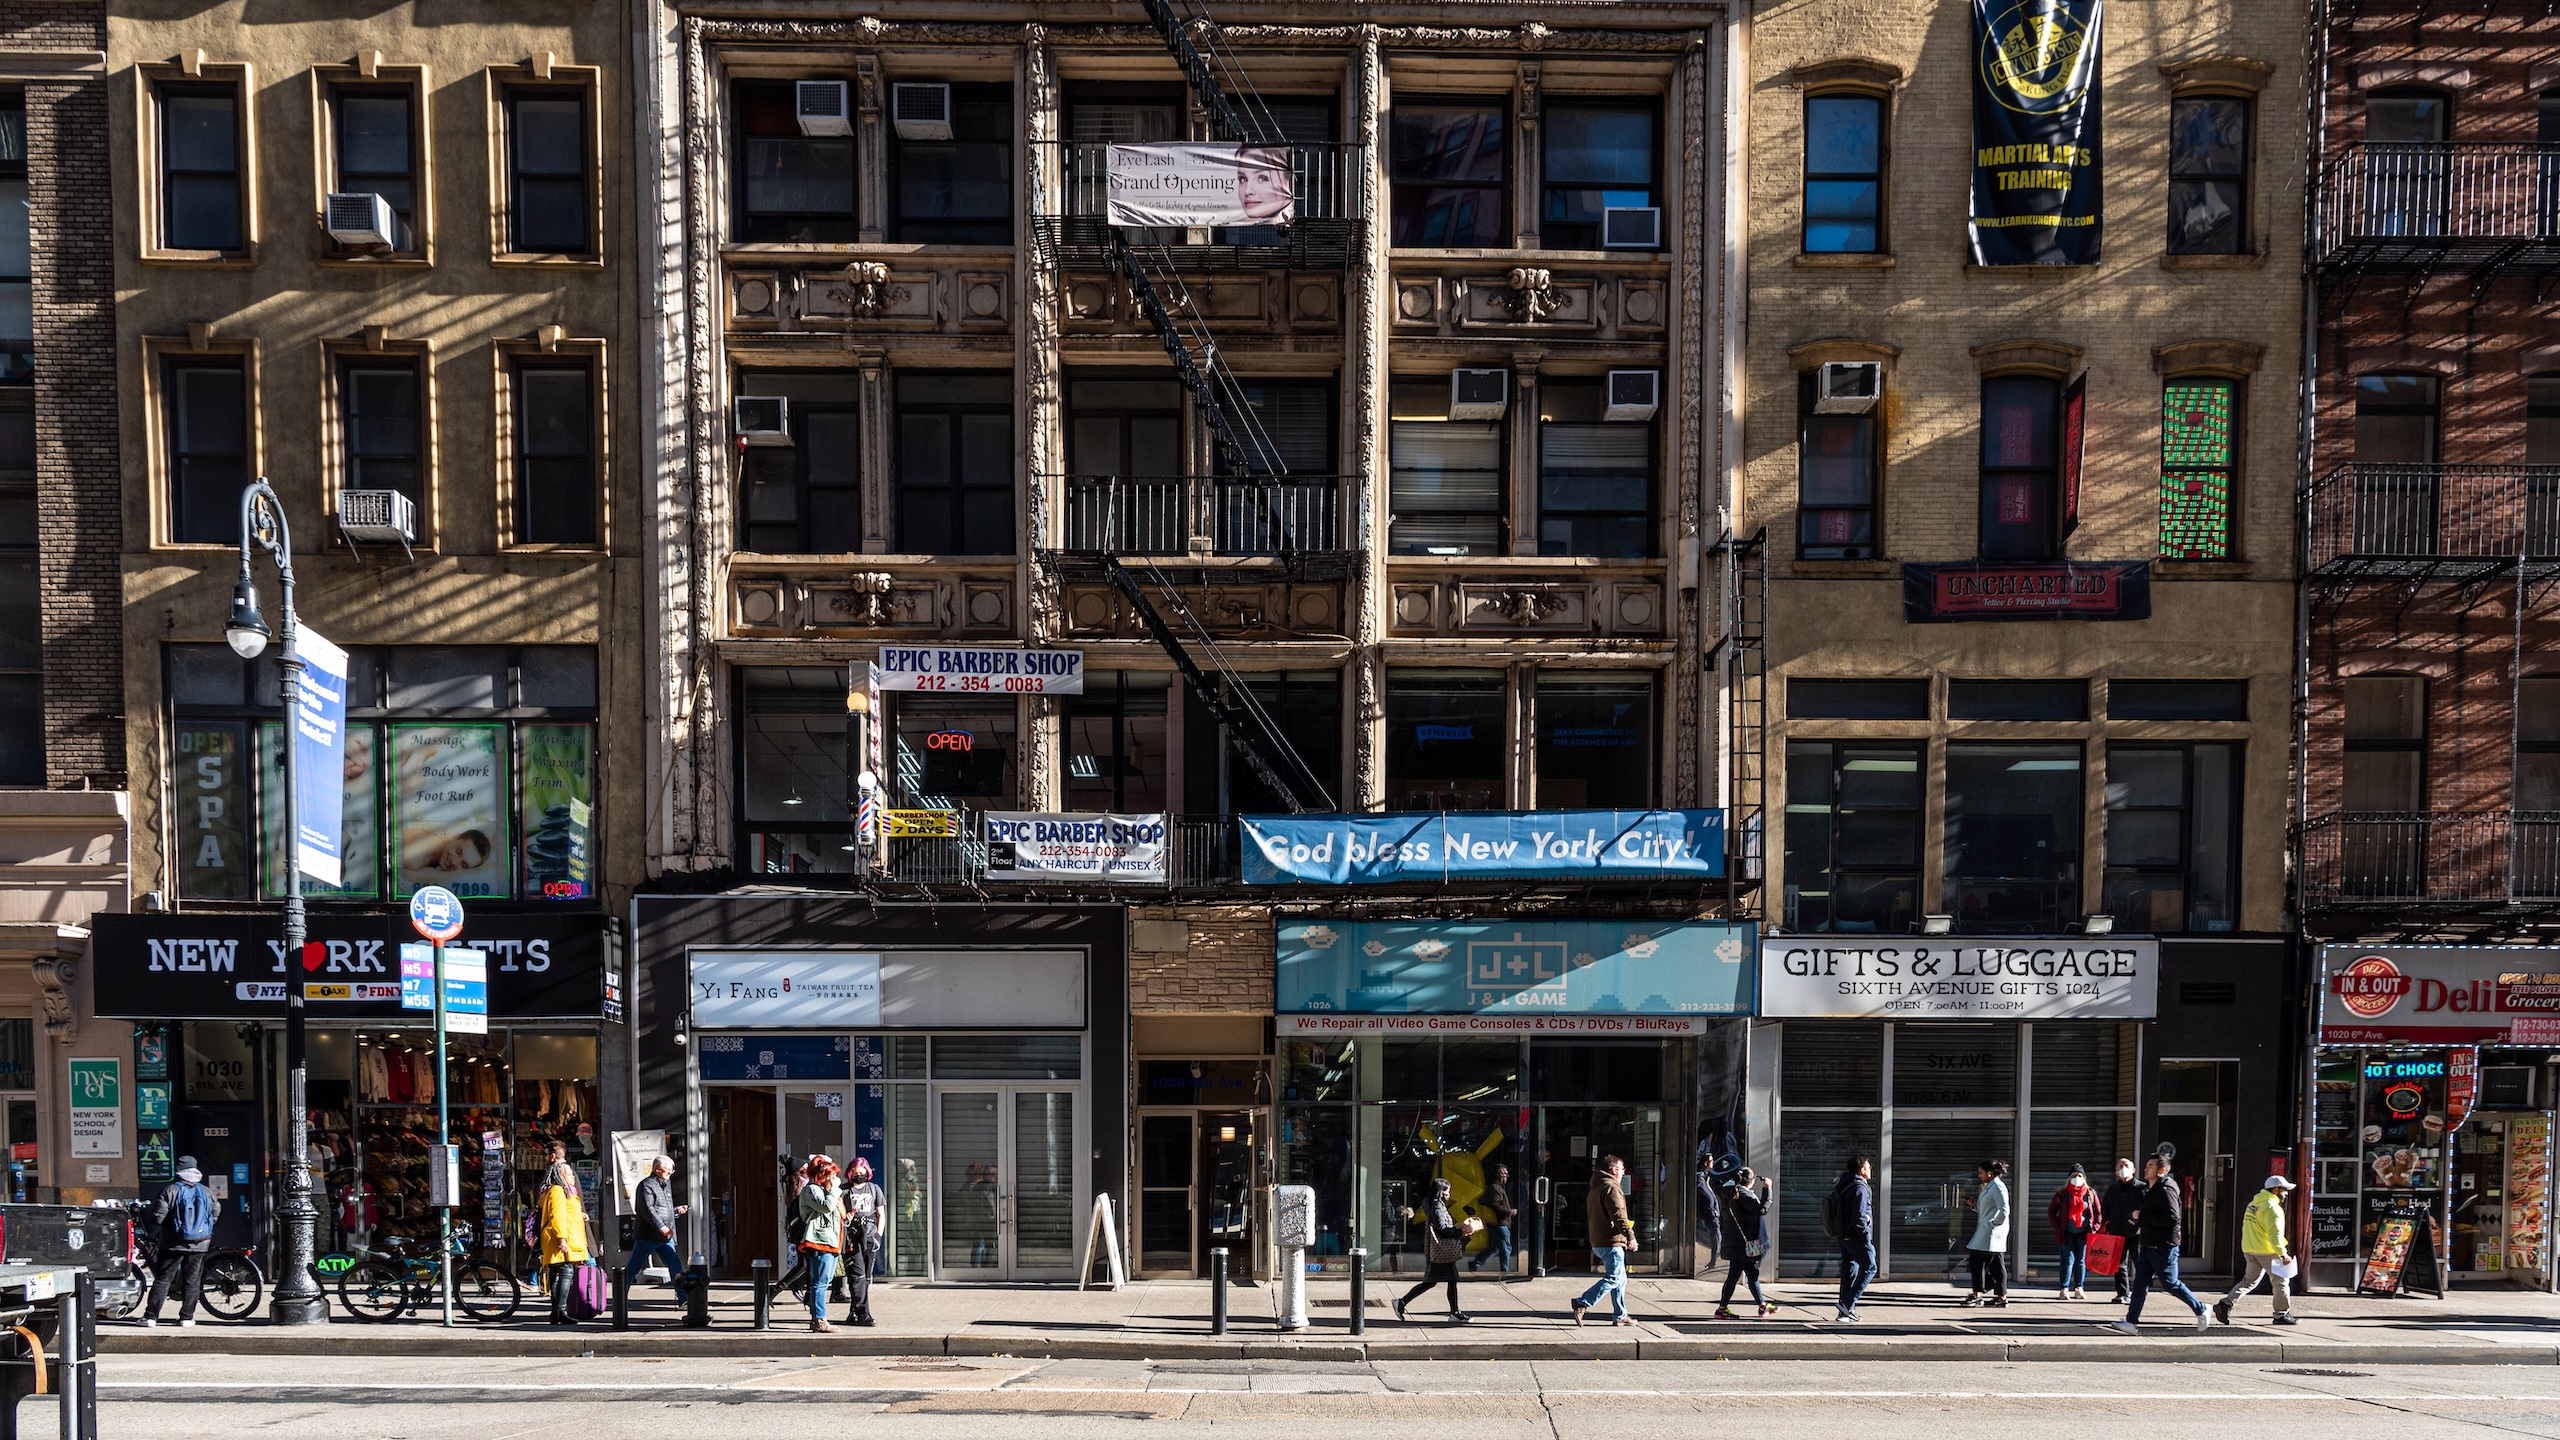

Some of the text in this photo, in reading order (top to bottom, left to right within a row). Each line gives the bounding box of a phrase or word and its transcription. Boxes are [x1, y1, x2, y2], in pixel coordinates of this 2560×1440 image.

[1994, 60, 2019, 80] CITY
[2050, 33, 2083, 60] TSUN
[2026, 68, 2071, 95] KUNG FU
[1117, 153, 1142, 169] Eye
[1145, 152, 1175, 166] Lash
[1978, 143, 2091, 167] MARTIAL ARTS
[1110, 173, 1236, 194] Grand Opening
[1997, 169, 2072, 191] TRAINING
[2015, 504, 2025, 518] 3rd
[1948, 575, 2108, 597] UNCHARTED
[1983, 596, 2071, 608] Tattoo & Piercing Studio
[885, 649, 1080, 676] EPIC BARBER SHOP
[916, 675, 1044, 692] 212 354 0083
[1420, 727, 1468, 738] KENEKTID
[1554, 728, 1573, 736] STAY
[1575, 728, 1625, 736] CONNECTED
[180, 732, 235, 753] OPEN
[411, 734, 465, 749] Massage
[531, 733, 582, 745] Haircut
[927, 733, 972, 752] OPEN
[1553, 738, 1569, 746] THE
[1571, 738, 1607, 746] ESSENCE
[1609, 738, 1619, 746] OF
[536, 756, 585, 771] Waxing
[532, 776, 562, 788] Trim
[415, 790, 474, 804] Foot Rub
[196, 756, 224, 867] SPA
[894, 811, 944, 819] BARBERSHOP
[894, 826, 944, 834] 7 DAYS
[988, 820, 1164, 845] EPIC BARBER SHOP
[1040, 845, 1127, 858] 212-354-0083
[1345, 831, 1430, 864] bless
[1444, 832, 1519, 861] New
[1531, 831, 1605, 859] York
[991, 857, 1013, 866] Floor
[1019, 859, 1151, 871] ANY HAIRCUT UNISEX
[543, 882, 582, 895] OPEN
[427, 924, 460, 939] STANDING
[147, 939, 239, 972] NEW
[403, 947, 420, 959] M5
[404, 963, 421, 975] M5
[1783, 948, 2138, 978] GIFTS & LUGGAGE
[2362, 963, 2386, 975] DELI
[2498, 972, 2528, 984] OPEN
[321, 986, 346, 996] TAXI
[403, 979, 421, 991] M7
[1838, 981, 2101, 1000] SIXTH AVENUE GIFTS 1024
[2341, 977, 2402, 993] IN & OUT
[2511, 985, 2560, 994] FREE DELIVER
[370, 986, 402, 997] FDNY
[2413, 978, 2494, 1013] Deli
[405, 995, 430, 1007] M55
[1467, 992, 1567, 1006] J & L GAME
[2351, 994, 2388, 1010] GROCERY
[1307, 1001, 1331, 1010] 1026
[1680, 1001, 1748, 1012] 212-233-3399
[1885, 1001, 2024, 1010] OPEN: 7:00AM 11:00PM
[1297, 1018, 1317, 1028] We
[1322, 1018, 1364, 1030] Repair
[1368, 1017, 1383, 1028] all
[1387, 1018, 1424, 1028] Video
[1428, 1018, 1466, 1029] Game
[1470, 1018, 1531, 1029] Consoles
[1535, 1019, 1544, 1029] &
[1549, 1018, 1576, 1029] CDs
[1588, 1019, 1623, 1030] DVDs
[1635, 1019, 1690, 1032] BluRays
[2328, 1030, 2385, 1039] 1020 6th Ave.
[1927, 1054, 1993, 1068] SIX AVE
[2453, 1054, 2465, 1065] IN
[195, 1061, 243, 1077] 1030
[2450, 1065, 2473, 1077] OUT
[195, 1081, 244, 1090] 6th AVE
[1152, 1077, 1246, 1088] 1026 6th Ave.
[2450, 1081, 2471, 1089] DELI
[2392, 1111, 2416, 1119] Brand
[107, 1120, 116, 1128] of
[2517, 1126, 2544, 1134] DELI
[140, 1133, 170, 1161] A
[2409, 1198, 2432, 1208] Head
[2313, 1206, 2350, 1215] Breakfast
[2318, 1223, 2344, 1232] Lunch
[2312, 1235, 2350, 1253] Specials
[317, 1258, 356, 1272] ATM
